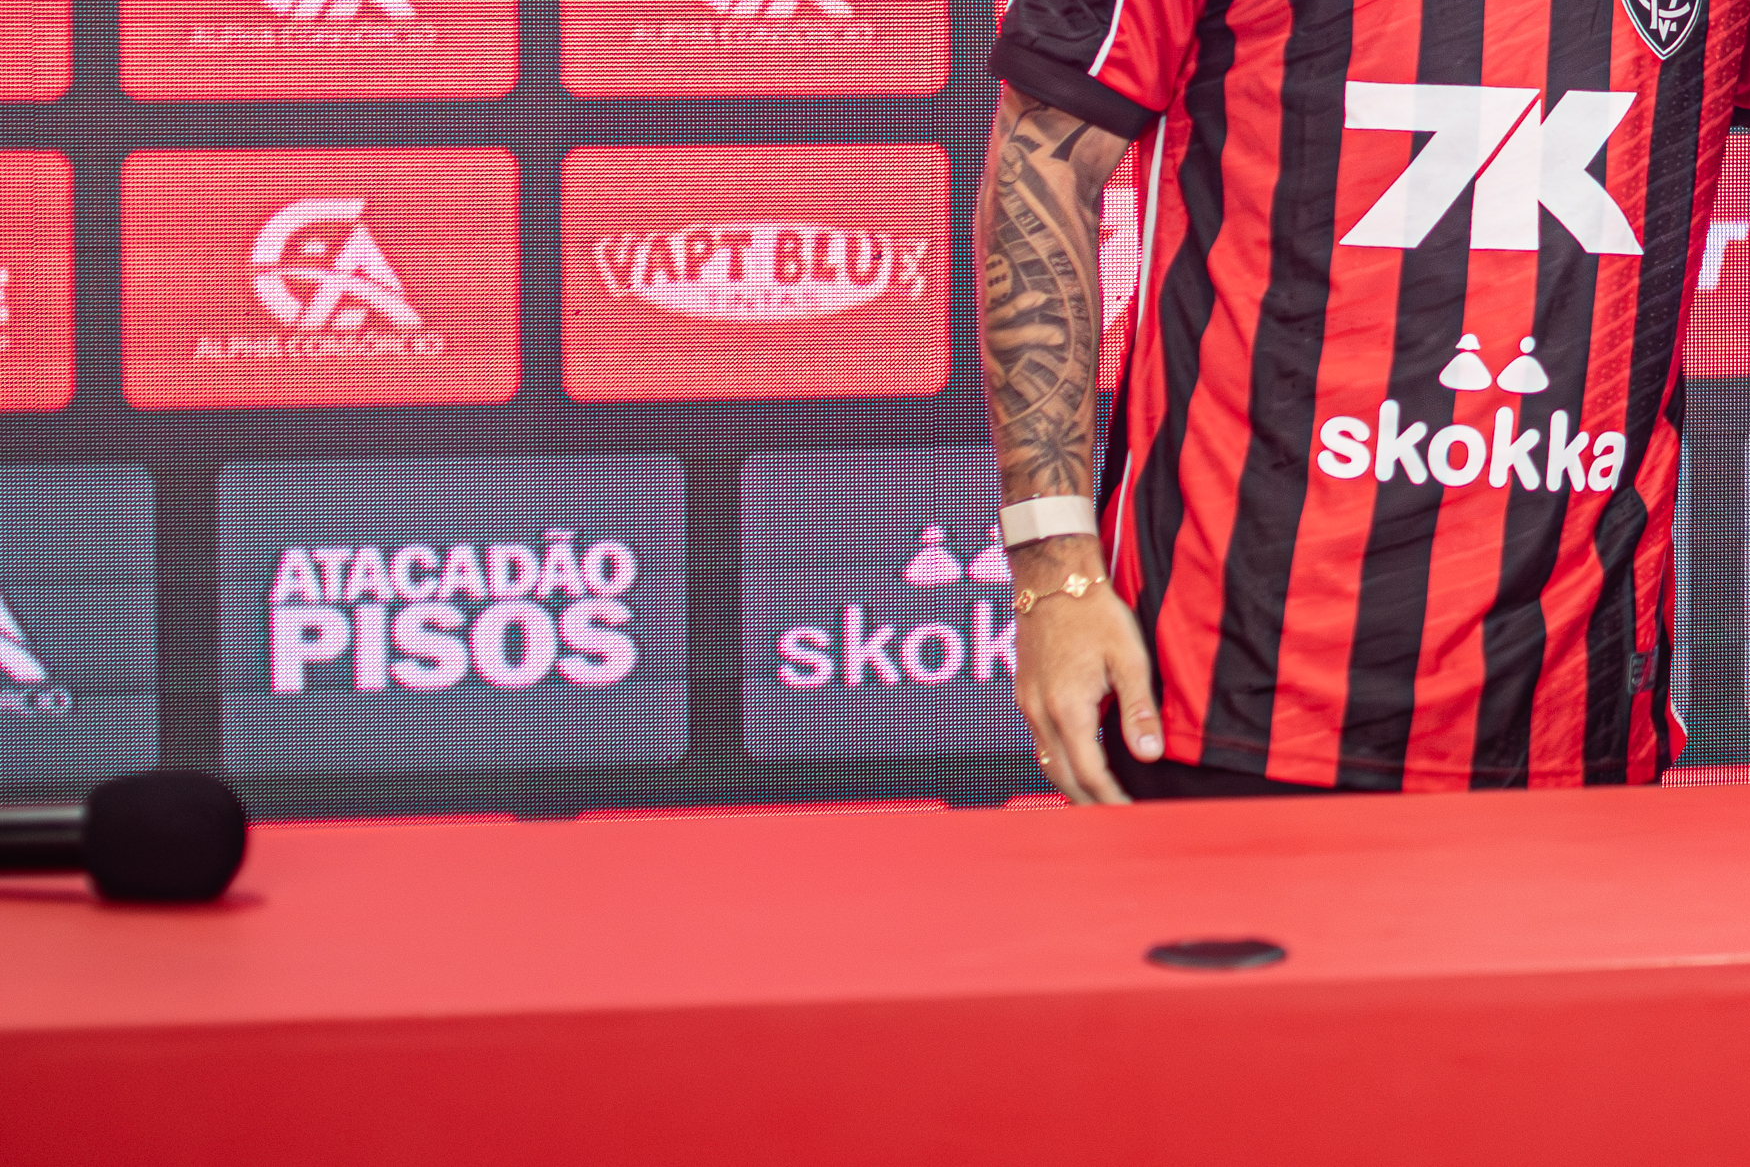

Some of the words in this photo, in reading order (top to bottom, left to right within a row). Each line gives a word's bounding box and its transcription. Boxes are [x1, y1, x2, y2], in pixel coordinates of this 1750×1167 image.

[1338, 80, 1646, 257] 7K
[1317, 399, 1628, 492] skokka
[268, 527, 639, 604] ATACADÃO
[268, 598, 641, 694] PISOS
[776, 599, 1018, 691] skok
